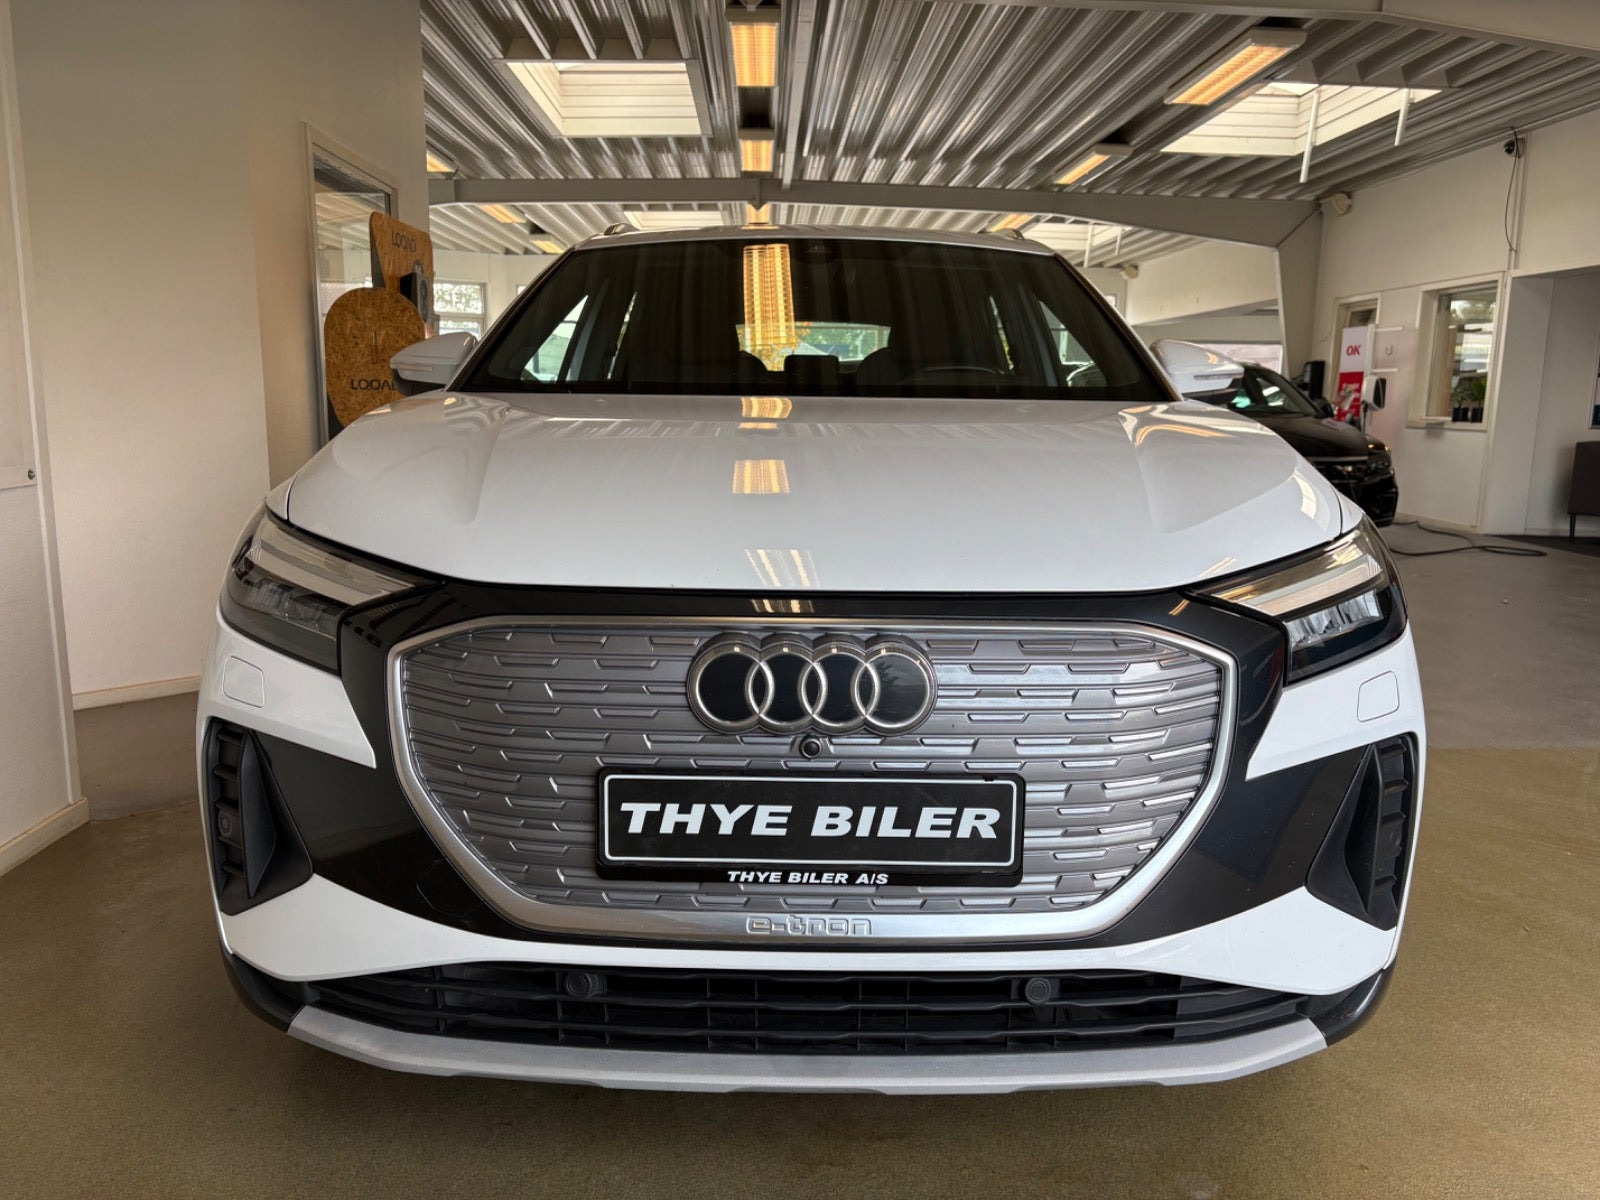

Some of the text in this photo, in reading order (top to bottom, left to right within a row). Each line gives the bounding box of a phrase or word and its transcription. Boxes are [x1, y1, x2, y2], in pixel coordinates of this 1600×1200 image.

[1346, 345, 1361, 356] OK
[350, 379, 395, 391] LOOA
[620, 802, 1001, 839] THYE BILER
[727, 870, 889, 886] THYE BILER A/S
[745, 914, 873, 936] e-tron
